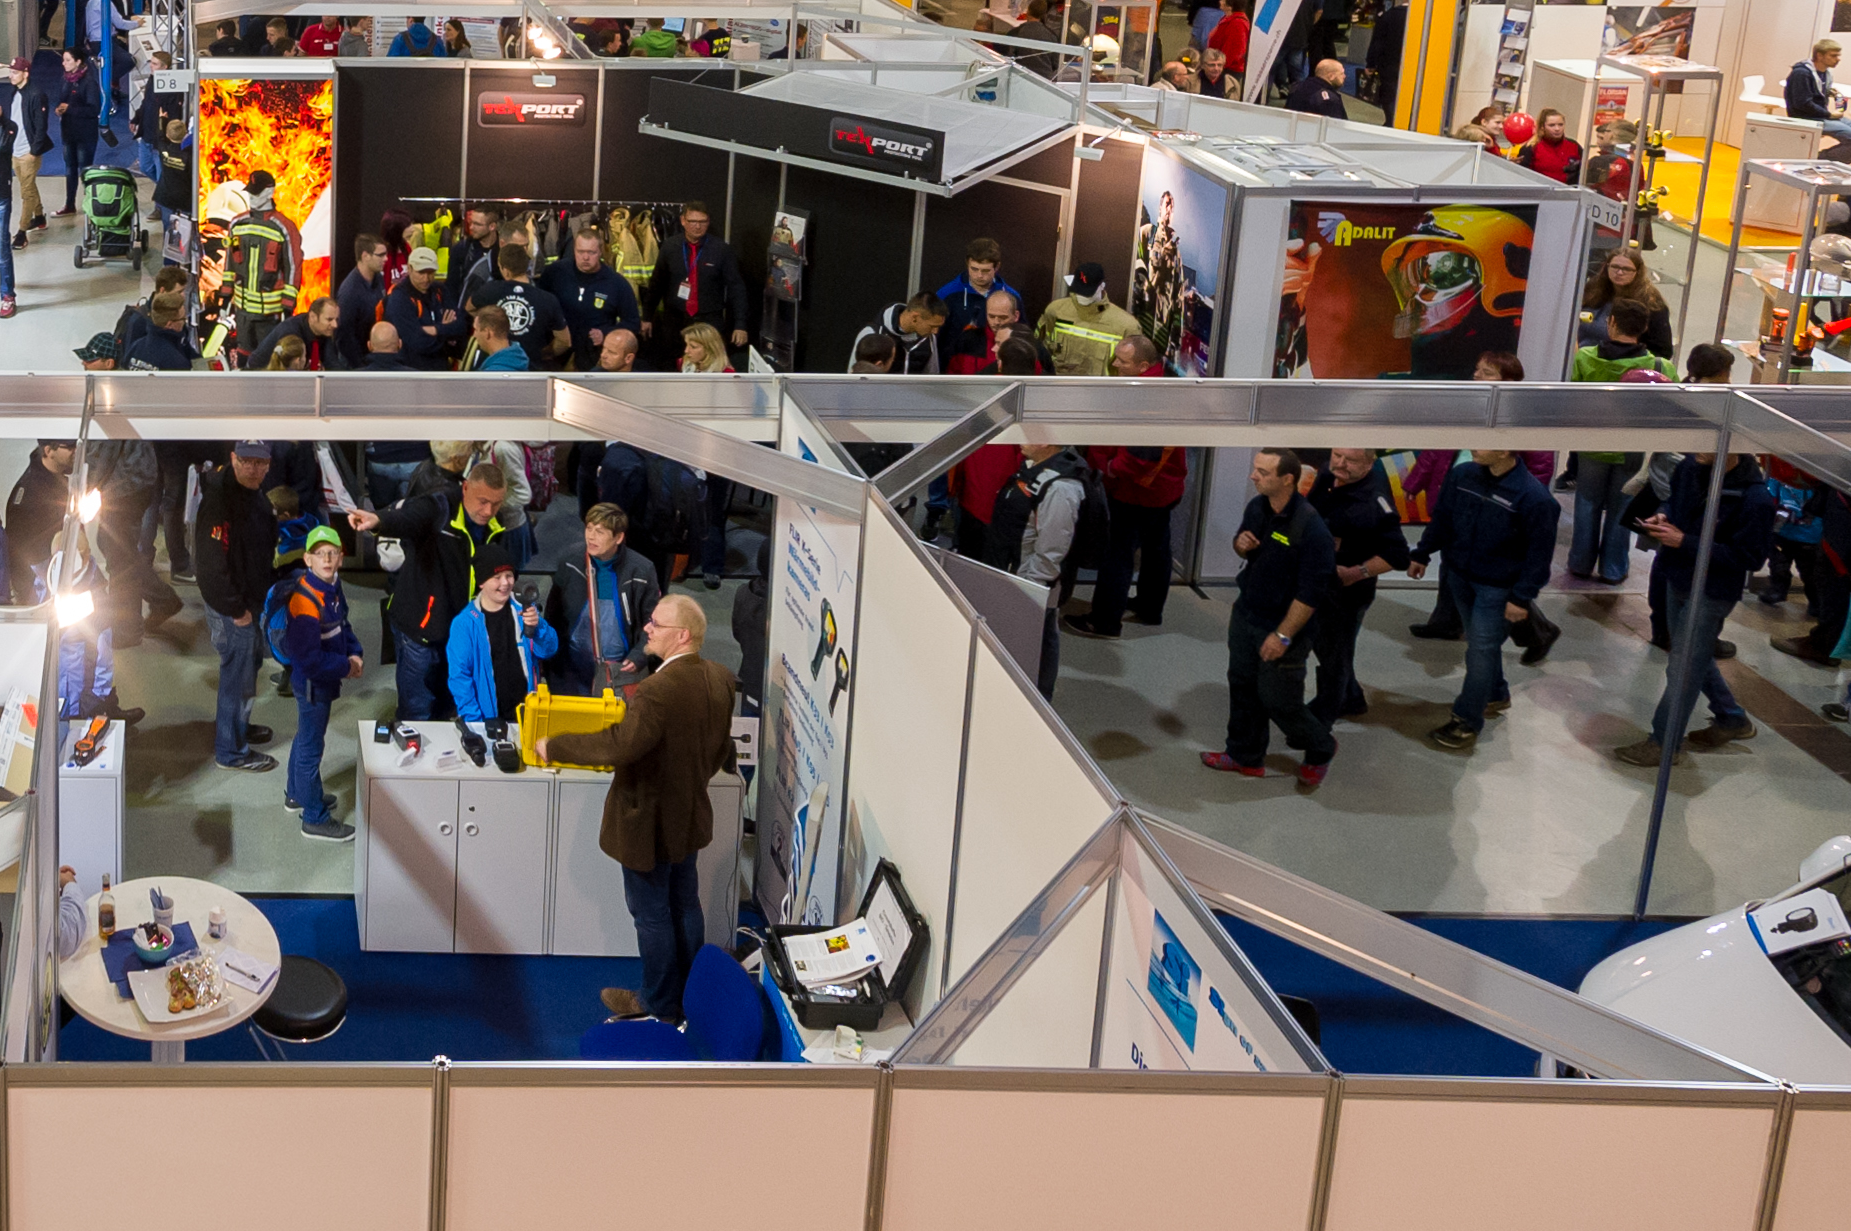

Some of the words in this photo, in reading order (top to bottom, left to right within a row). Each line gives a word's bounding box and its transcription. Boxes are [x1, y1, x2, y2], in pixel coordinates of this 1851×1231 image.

[156, 78, 166, 90] D
[169, 78, 177, 90] 8
[1592, 204, 1601, 219] D
[1605, 211, 1619, 227] 10
[1334, 220, 1397, 247] ADALIT
